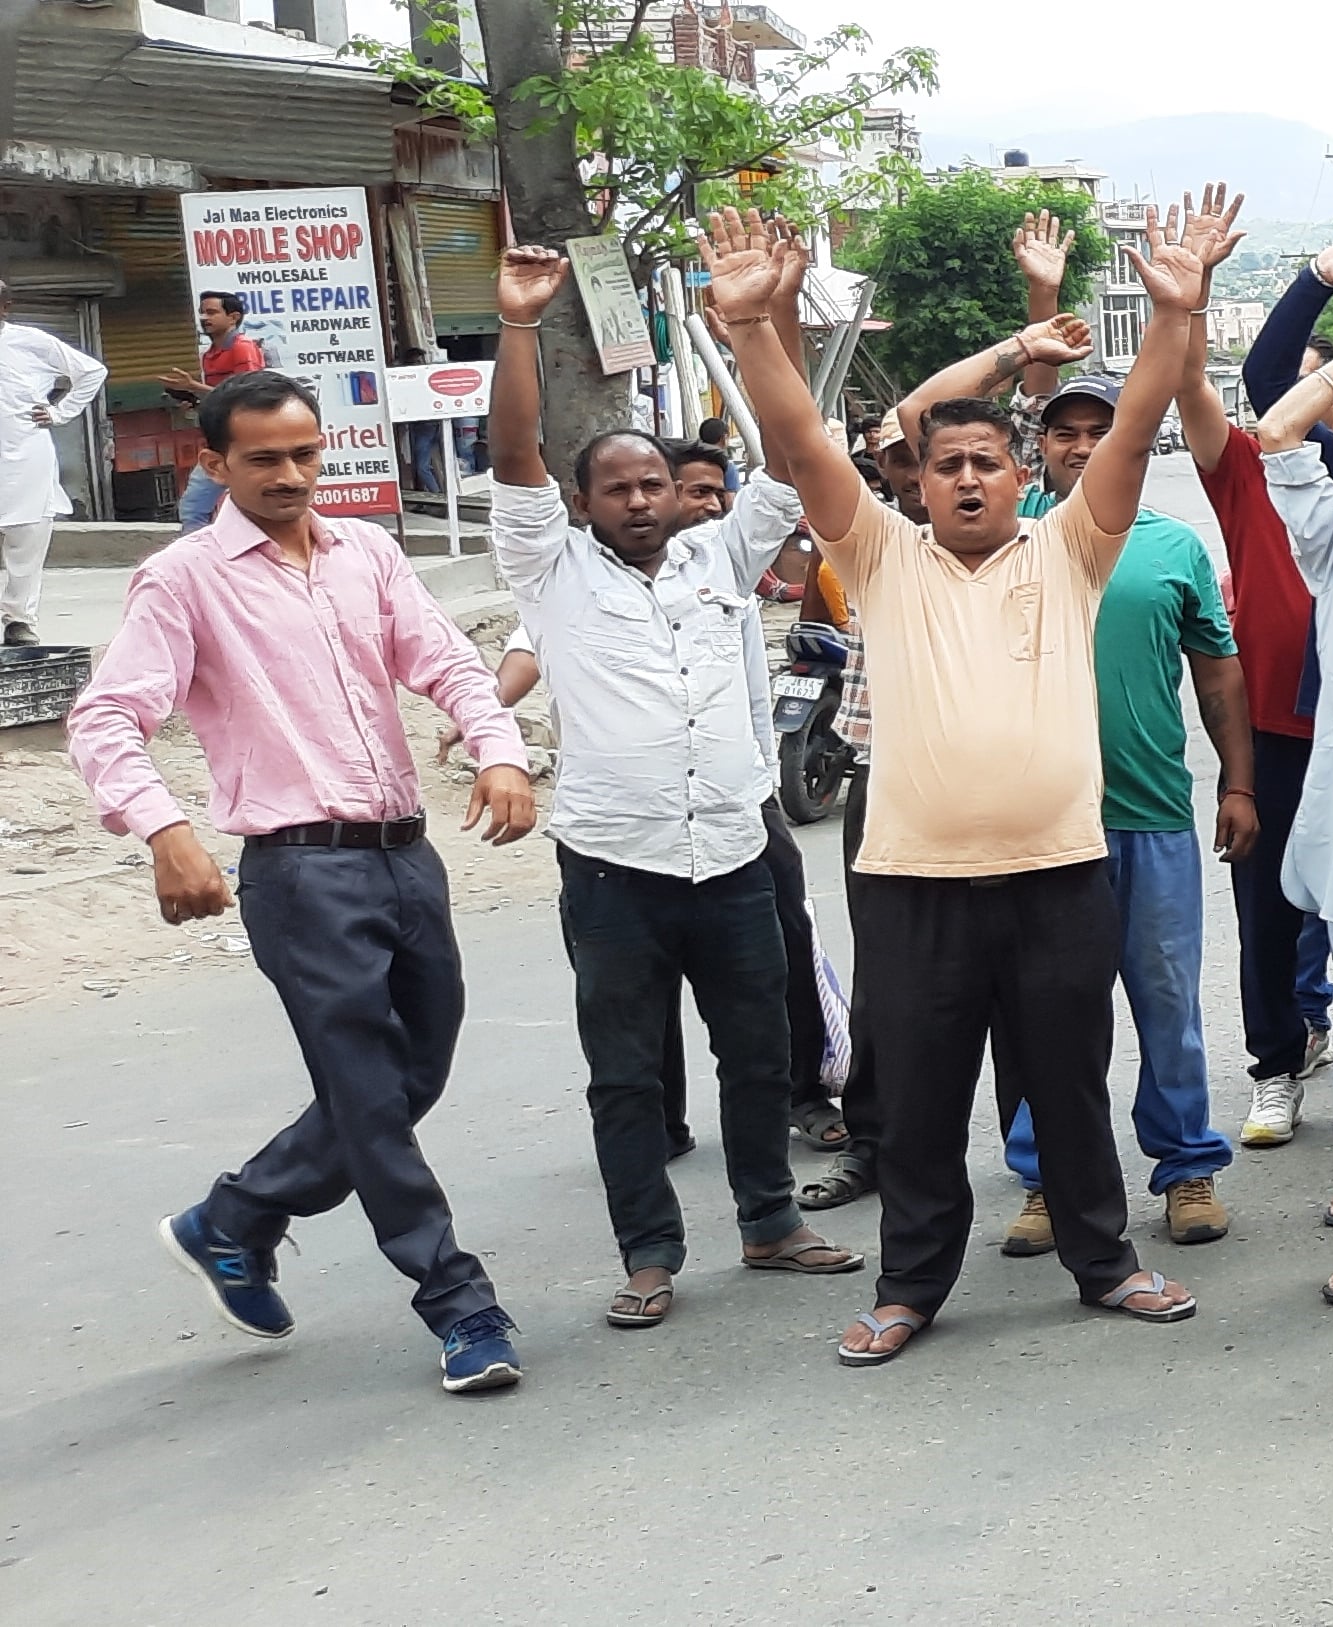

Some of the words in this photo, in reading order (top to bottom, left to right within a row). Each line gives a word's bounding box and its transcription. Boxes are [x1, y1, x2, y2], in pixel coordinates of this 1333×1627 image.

[230, 207, 260, 222] Maa
[265, 204, 348, 221] Electronics
[193, 226, 291, 266] MOBILE
[295, 223, 363, 262] SHOP
[237, 267, 329, 285] WHOLESALE
[236, 290, 286, 315] BILE
[291, 285, 372, 312] REPAIR
[290, 316, 372, 333] HARDWARE
[329, 333, 340, 346] &
[297, 349, 376, 365] SOFTWARE
[355, 459, 390, 475] HERE
[313, 487, 380, 506] 6001687
